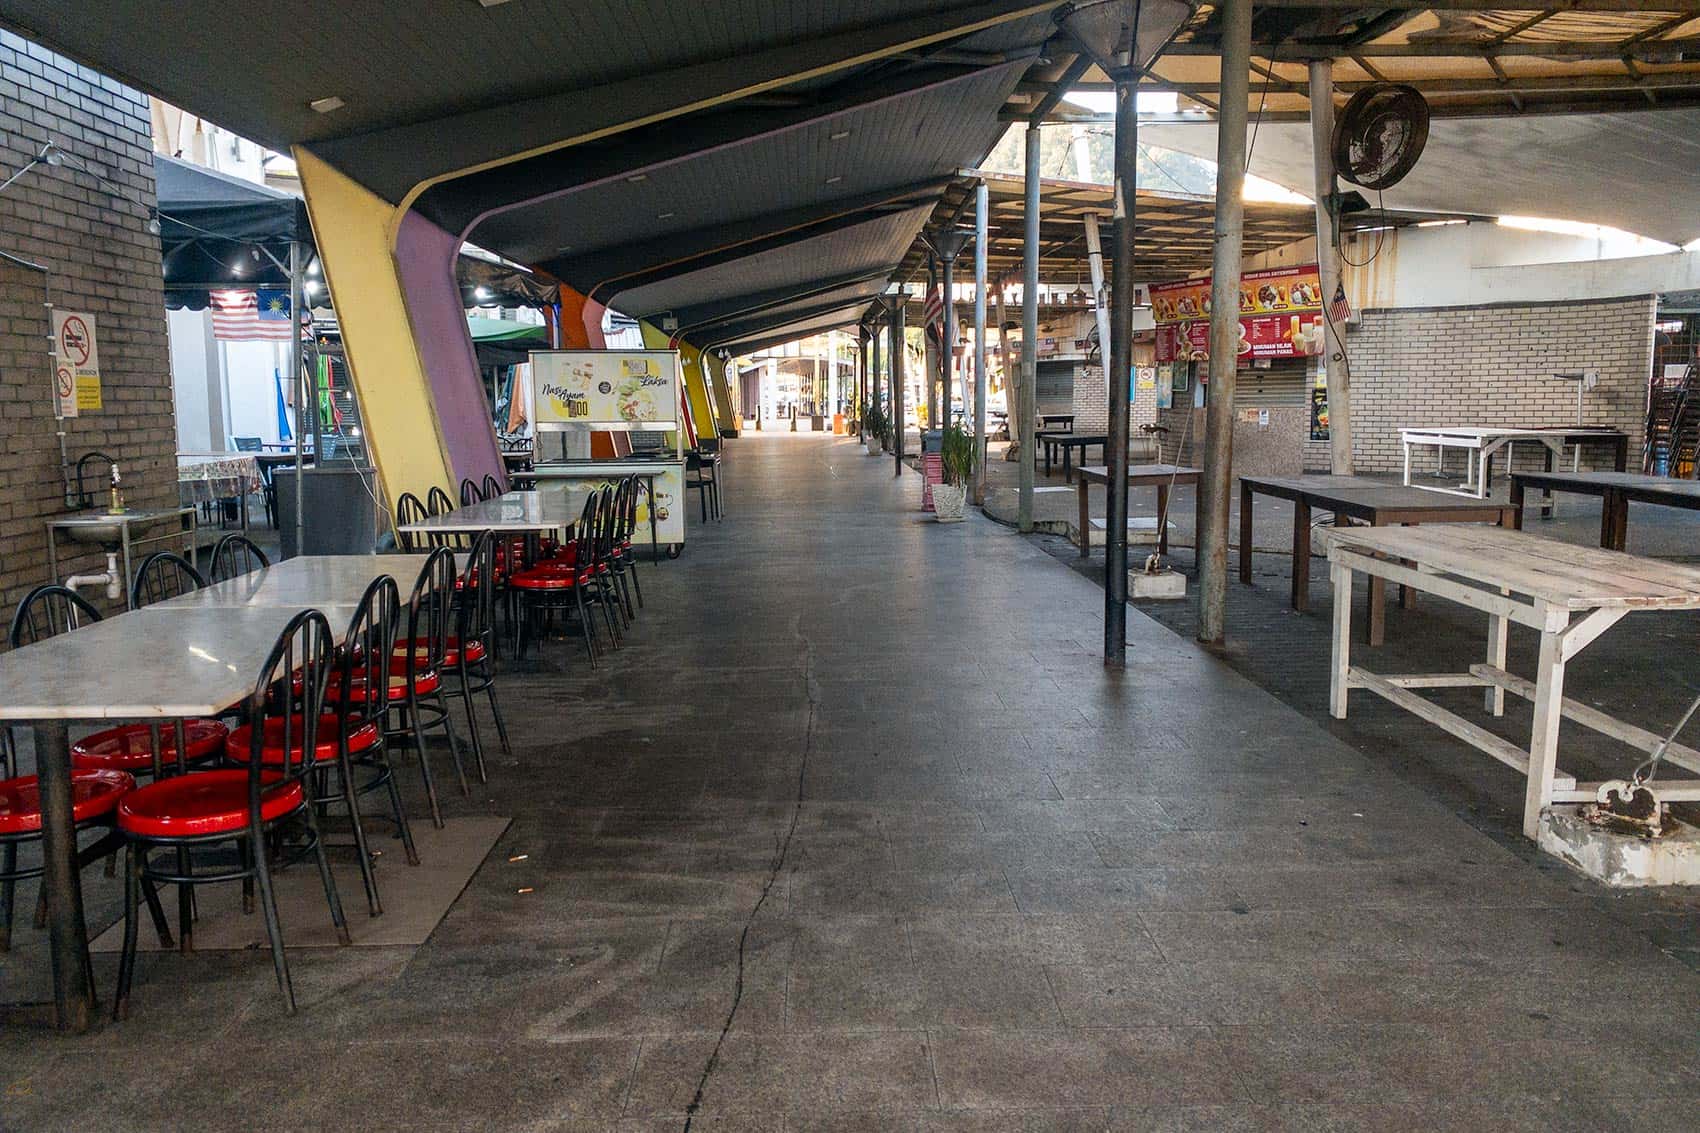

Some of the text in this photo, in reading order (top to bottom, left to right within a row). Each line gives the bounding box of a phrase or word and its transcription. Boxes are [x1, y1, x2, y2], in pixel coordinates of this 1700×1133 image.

[640, 374, 667, 387] Laksa
[542, 384, 585, 401] Nasi Ayam
